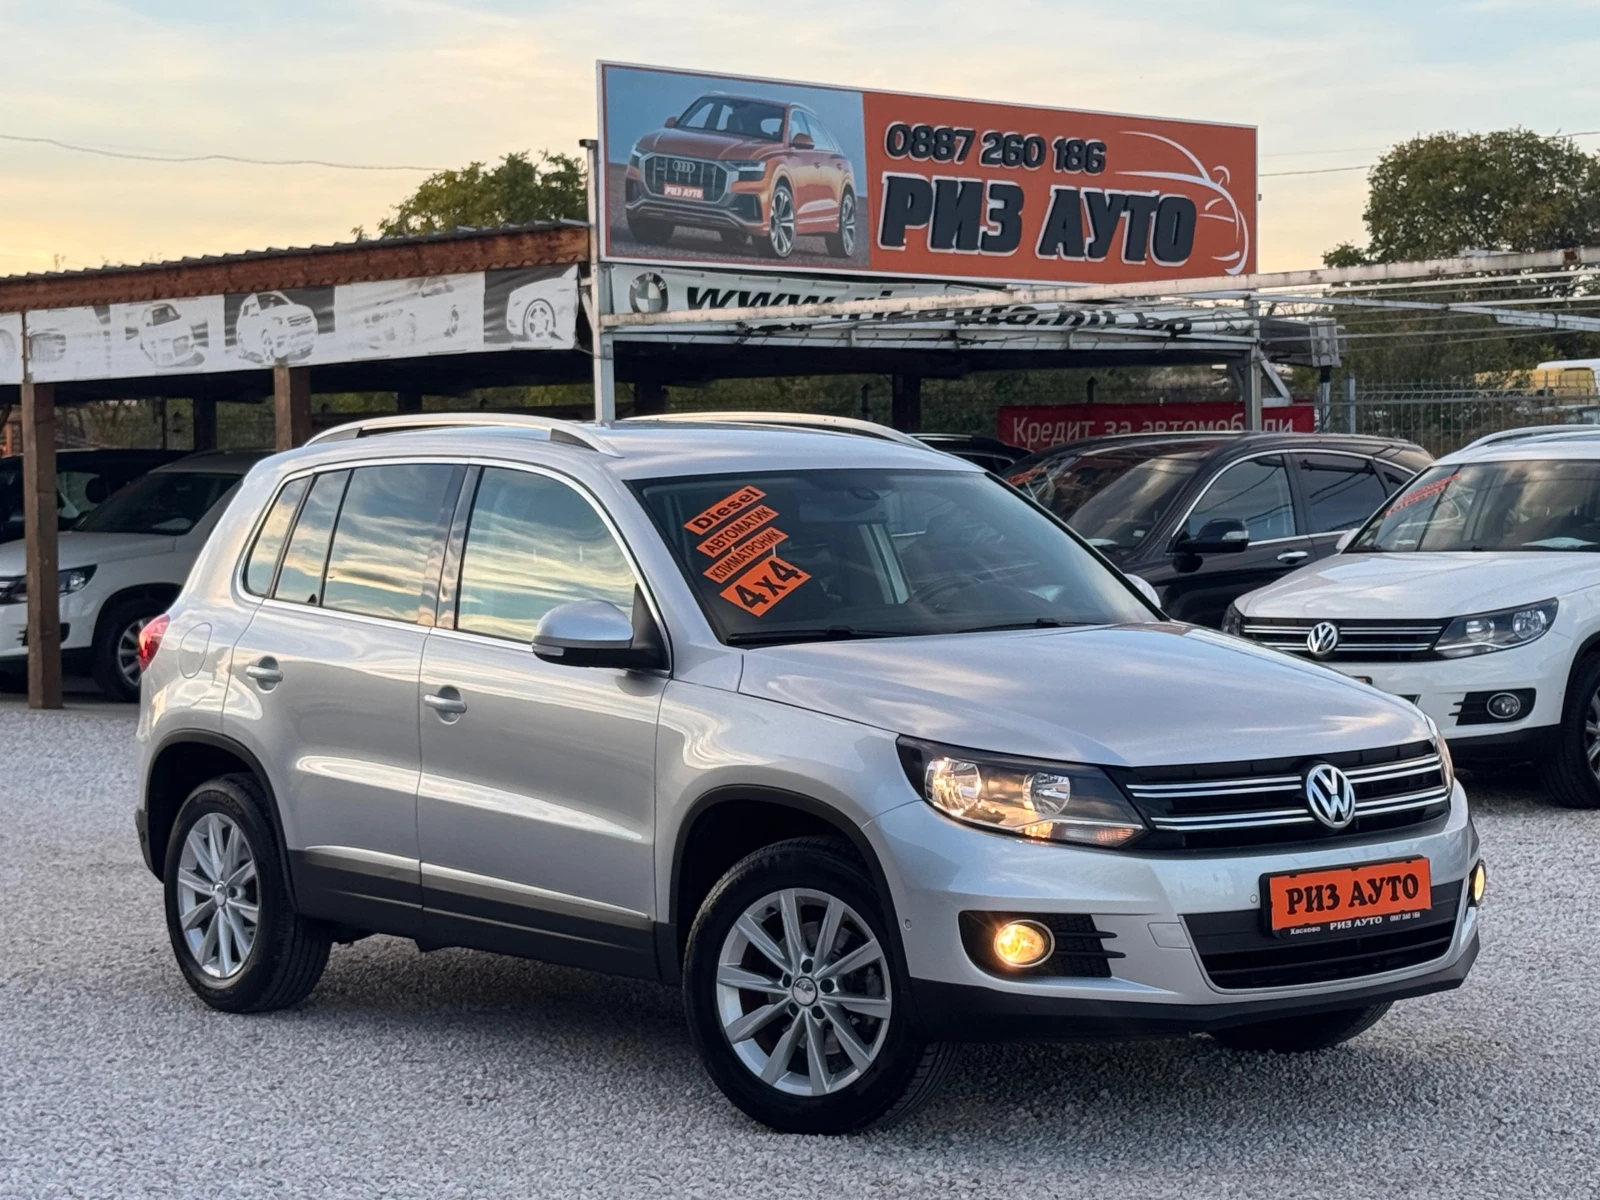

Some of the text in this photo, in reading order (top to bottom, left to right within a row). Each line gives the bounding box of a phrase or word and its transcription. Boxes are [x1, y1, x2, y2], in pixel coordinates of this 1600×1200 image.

[885, 121, 1107, 174] 0887 260 186
[877, 172, 1197, 267] РИЗ АУТО
[1013, 417, 1095, 449] Кредит
[1142, 413, 1294, 434] автомобли
[693, 488, 760, 530] Diesel
[704, 507, 772, 554] АВТОМАТИК
[710, 530, 783, 579] КЛИМАТРОНИК
[1285, 873, 1419, 915] РИЗ АУТО
[1329, 920, 1352, 931] РИЗ
[1354, 916, 1383, 928] АУТО
